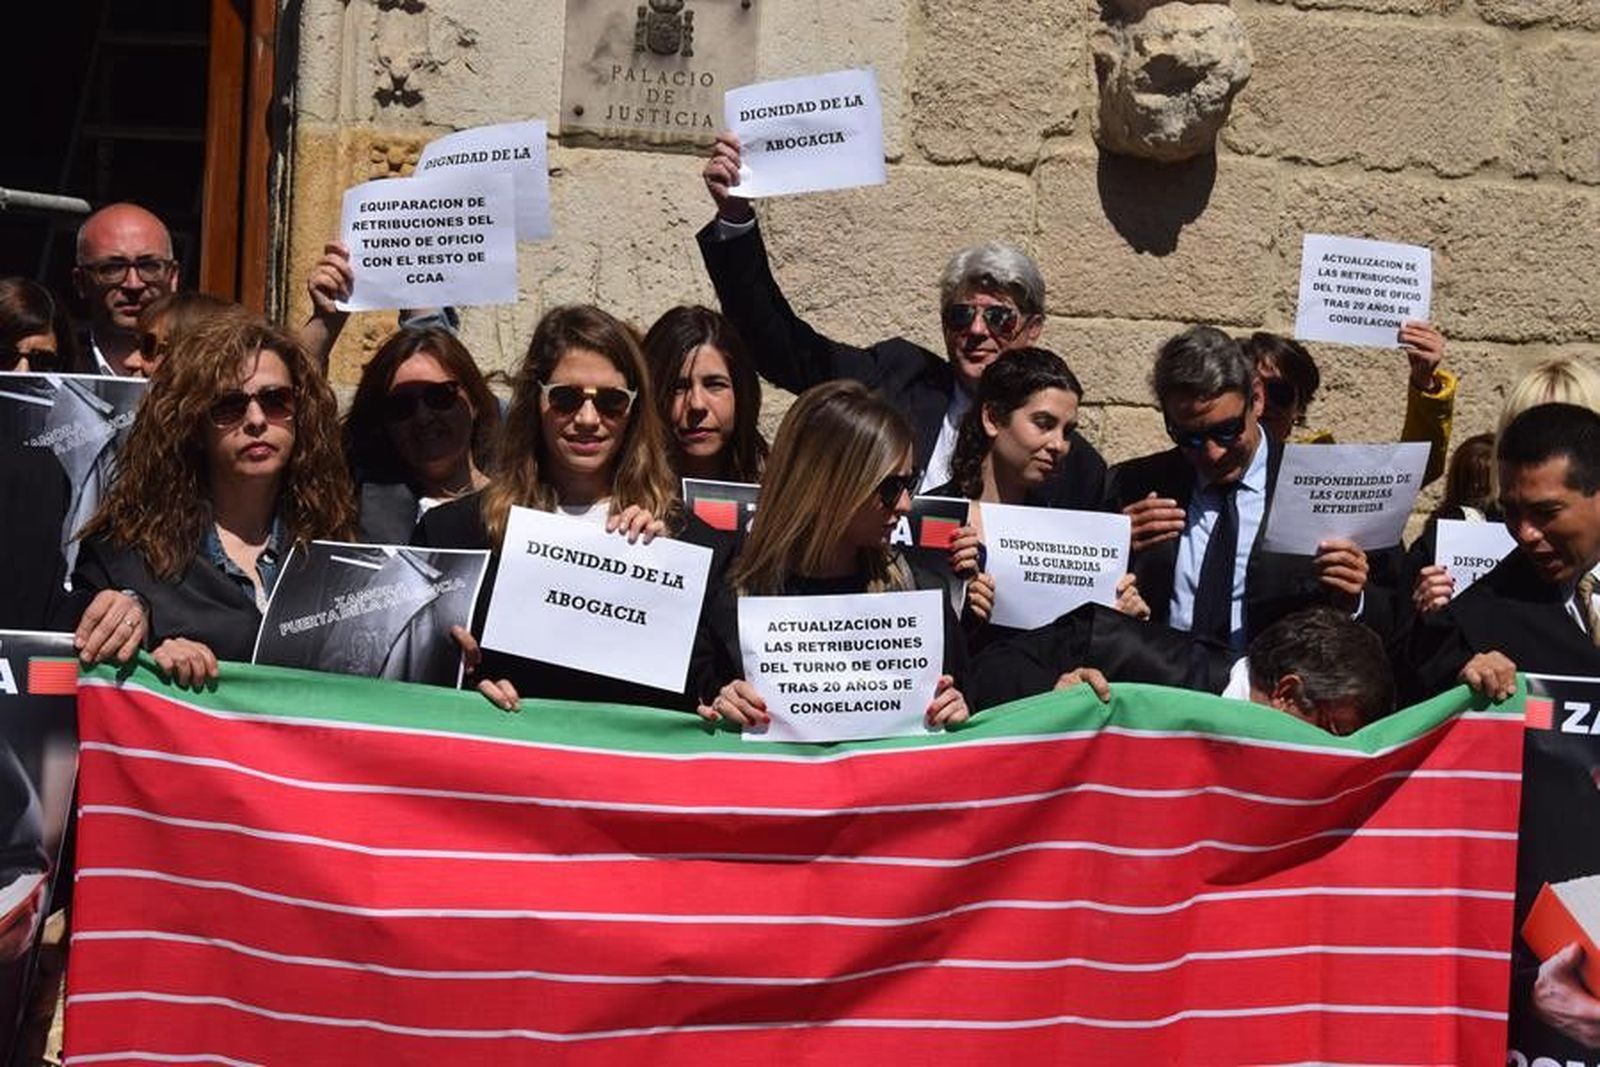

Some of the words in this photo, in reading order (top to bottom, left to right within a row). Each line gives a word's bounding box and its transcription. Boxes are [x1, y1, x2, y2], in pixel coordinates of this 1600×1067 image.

[611, 64, 715, 88] PALACIO
[647, 88, 675, 105] DE
[605, 104, 714, 128] JUSTICIA
[739, 102, 817, 122] DIGNIDAD
[820, 97, 841, 111] DE
[844, 94, 864, 109] LA
[765, 131, 845, 152] ABOGACIA
[424, 152, 488, 170] DIGNIDAD
[491, 149, 511, 161] DE
[513, 147, 531, 160] LA
[359, 199, 464, 213] EQUIPARACION
[467, 197, 486, 207] DE
[351, 216, 464, 231] RETRIBUCIONES
[467, 214, 494, 225] DEL
[362, 236, 411, 250] TURNO
[414, 235, 434, 247] DE
[437, 233, 485, 246] OFICIO
[362, 256, 393, 268] CON
[396, 255, 414, 266] EL
[417, 253, 464, 266] RESTO
[467, 251, 486, 263] DE
[1322, 254, 1403, 269] ACTUALIZACION
[1405, 263, 1417, 271] DE
[406, 272, 445, 285] CCAA
[1318, 268, 1338, 278] LAS
[1340, 270, 1418, 286] RETRIBUCIONES
[1313, 282, 1333, 292] DEL
[1336, 285, 1372, 297] TURNO
[1373, 288, 1387, 298] DE
[1389, 291, 1421, 302] OFICIO
[1323, 298, 1350, 309] TRAS
[1352, 301, 1365, 310] 20
[1398, 306, 1411, 315] DE
[1329, 313, 1402, 328] CONGELACION
[1293, 475, 1394, 486] DISPONIBILIDAD
[1396, 474, 1412, 483] DE
[1309, 489, 1332, 500] LAS
[1334, 488, 1392, 500] GUARDIAS
[1312, 502, 1384, 514] RETRIBUIDA
[1000, 538, 1098, 557] DISPONIBILIDAD
[1101, 547, 1119, 559] DE
[526, 540, 627, 575] DIGNIDAD
[630, 563, 659, 583] DE
[662, 571, 685, 590] LA
[1019, 554, 1040, 567] LAS
[1043, 558, 1101, 571] GUARDIAS
[1024, 571, 1095, 587] RETRIBUIDA
[545, 589, 648, 625] ABOGACIA
[767, 618, 892, 633] ACTUALIZACION
[897, 616, 917, 628] DE
[764, 641, 794, 653] LAS
[797, 636, 923, 652] RETRIBUCIONES
[760, 661, 789, 673] DEL
[793, 661, 847, 673] TURNO
[851, 660, 872, 672] DE
[876, 657, 929, 670] OFICIO
[778, 681, 819, 694] TRAS
[822, 681, 841, 693] 20
[845, 677, 889, 692] AÑOS
[893, 678, 913, 690] DE
[790, 700, 901, 714] CONGELACION
